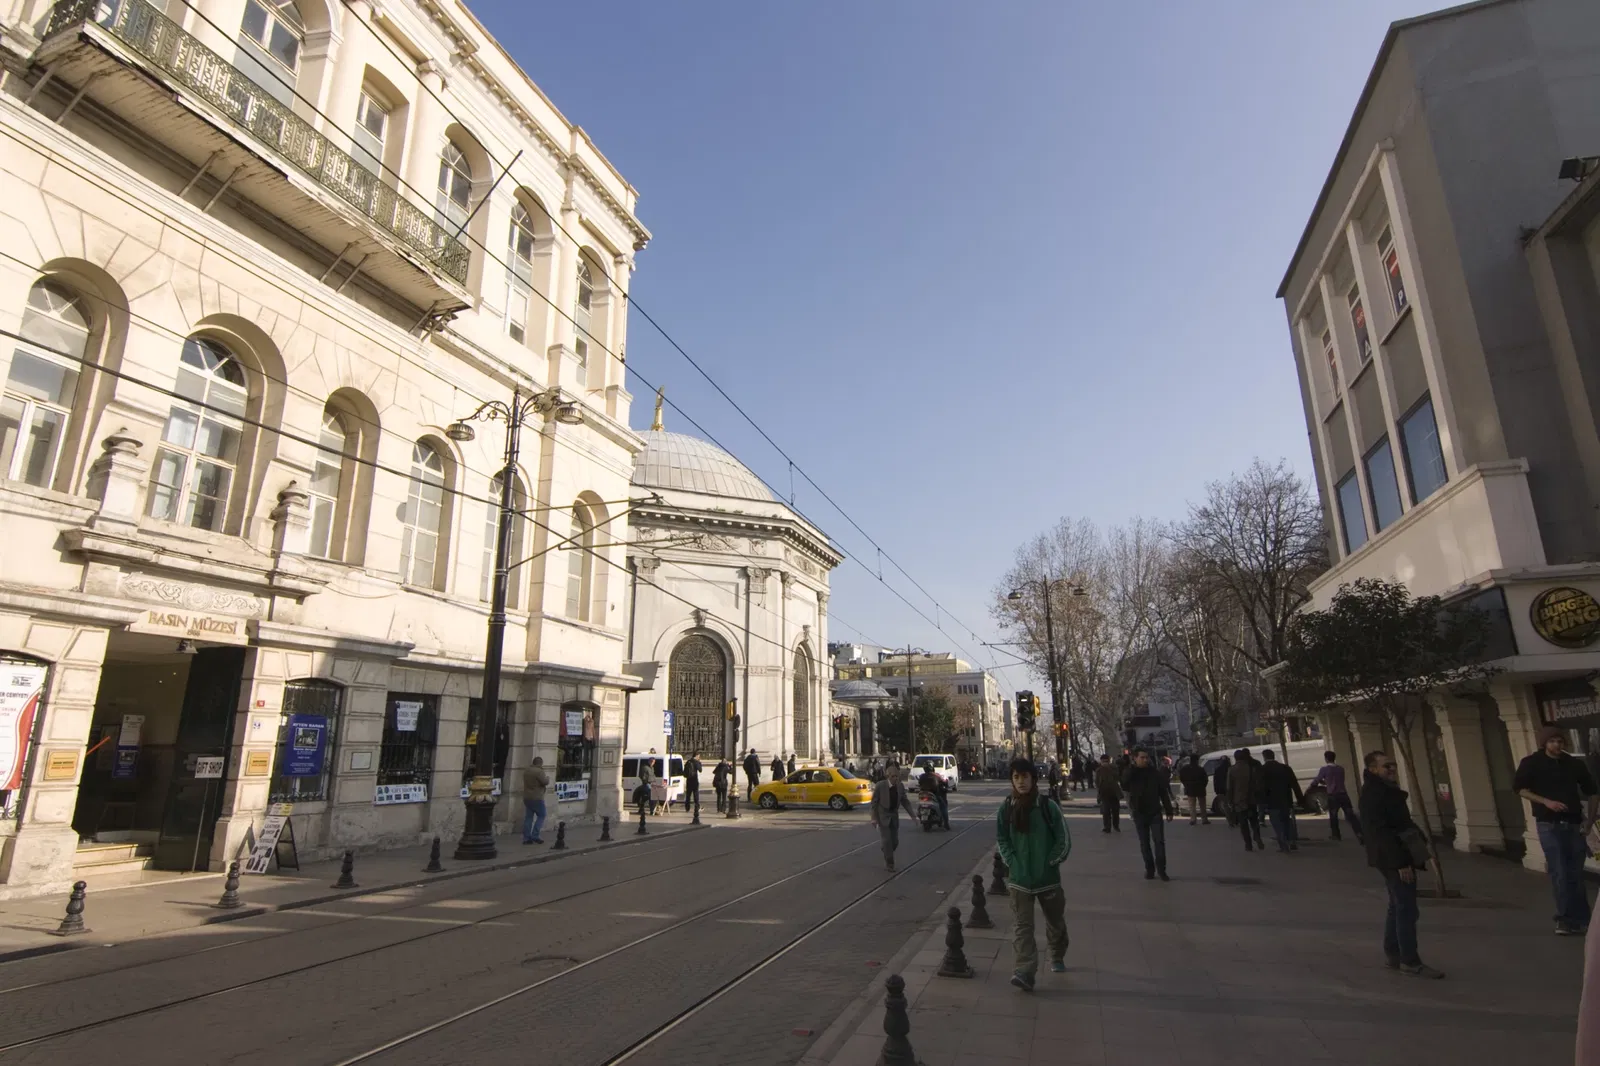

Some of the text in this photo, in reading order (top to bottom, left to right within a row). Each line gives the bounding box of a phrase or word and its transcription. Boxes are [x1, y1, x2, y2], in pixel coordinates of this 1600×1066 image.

[1398, 290, 1404, 306] P
[1540, 595, 1593, 620] BURGER
[1544, 605, 1600, 635] KING
[148, 610, 237, 635] BASIN MÜZESİ
[196, 761, 223, 775] GIFT SHOP
